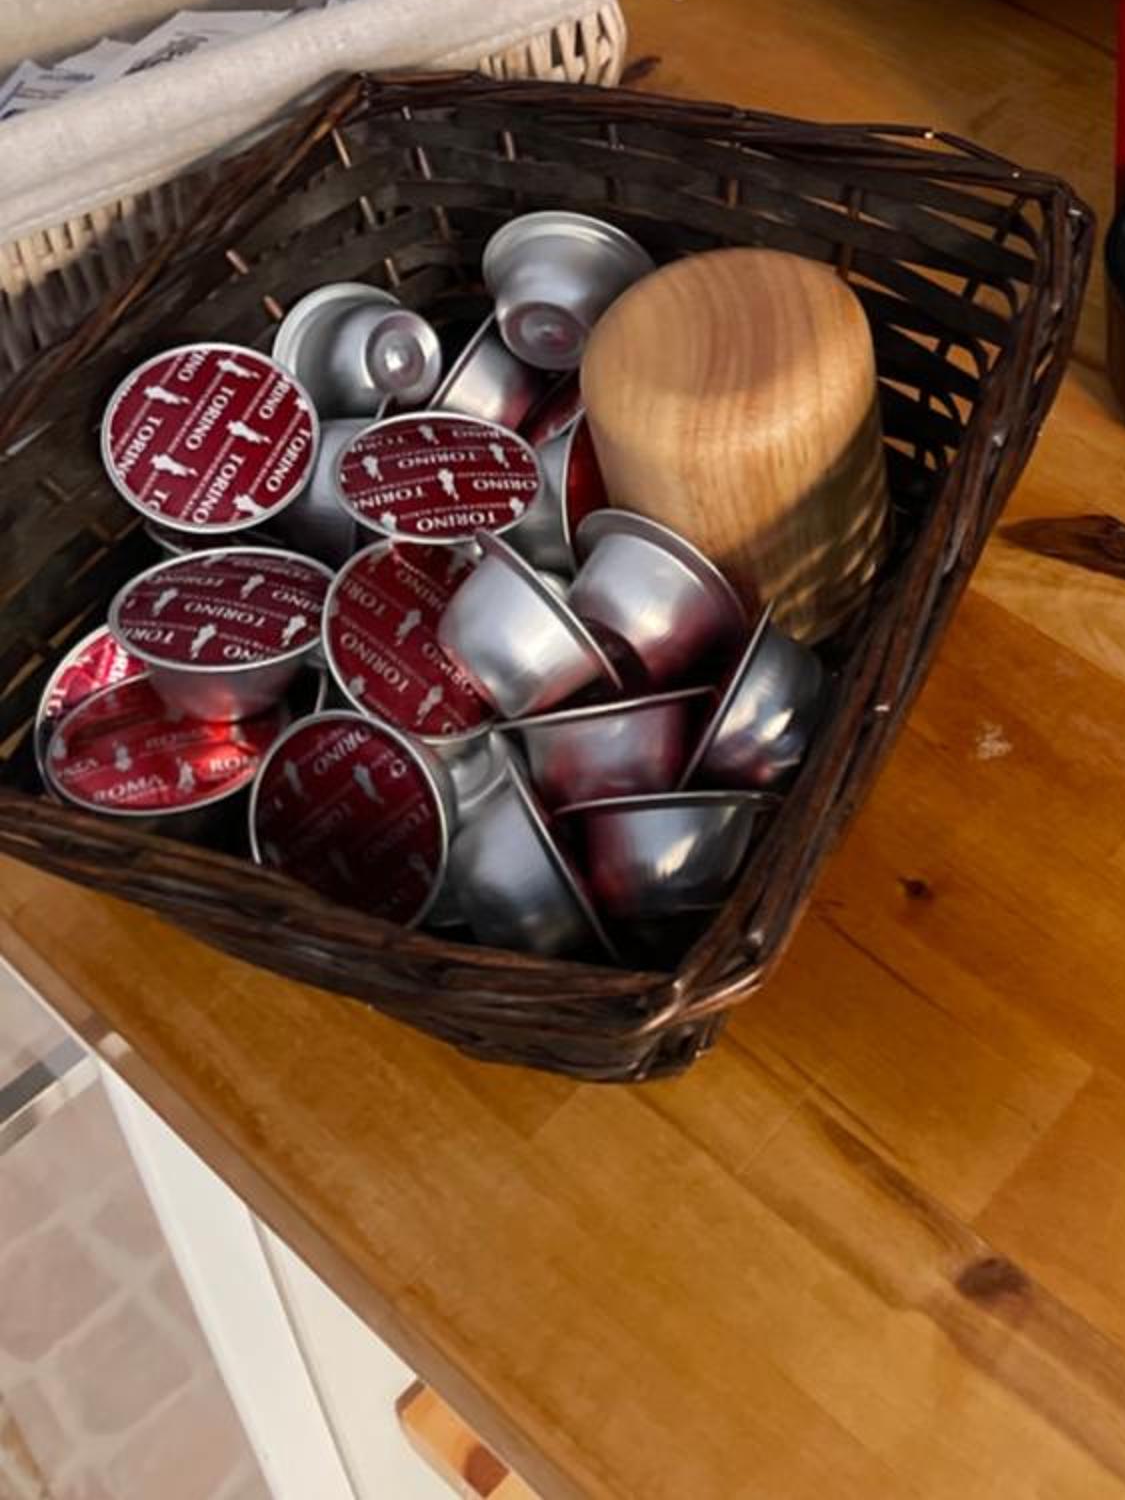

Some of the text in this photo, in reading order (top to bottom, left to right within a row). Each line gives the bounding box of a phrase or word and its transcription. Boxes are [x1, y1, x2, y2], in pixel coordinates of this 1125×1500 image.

[185, 386, 236, 450] TORINO
[265, 427, 312, 493] TORINO
[397, 451, 478, 469] TORINO
[192, 453, 247, 524] TORINO
[352, 485, 427, 510] TORIN
[416, 511, 498, 533] TORINO
[183, 601, 267, 628] TORINO
[339, 631, 410, 693] TORINO
